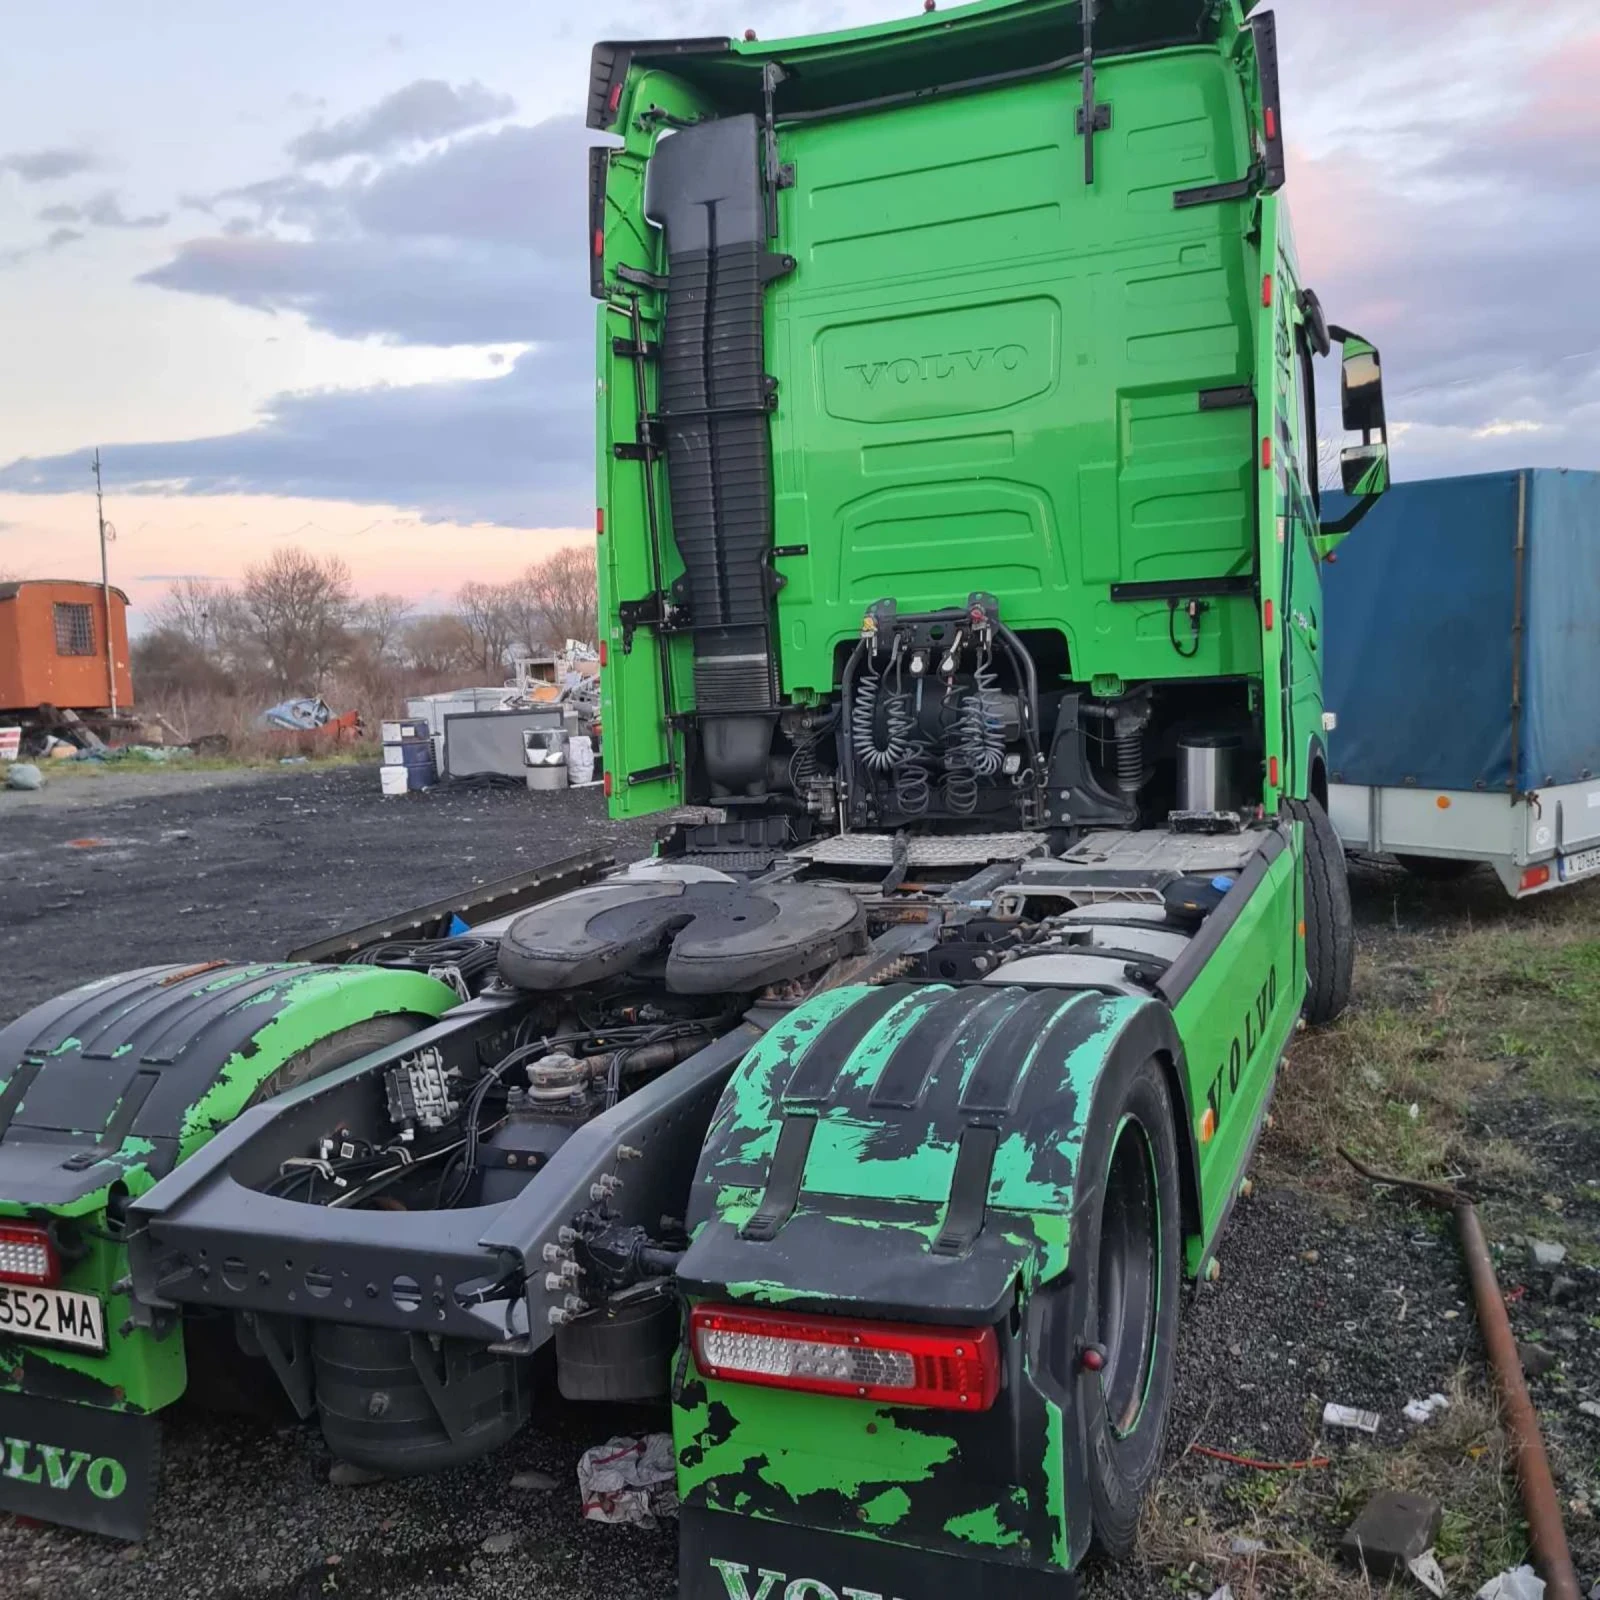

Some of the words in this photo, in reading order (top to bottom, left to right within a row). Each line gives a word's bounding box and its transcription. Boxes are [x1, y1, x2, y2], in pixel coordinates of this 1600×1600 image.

[843, 343, 1029, 391] VOLVO
[1207, 964, 1276, 1134] VOLVO
[55, 1295, 97, 1340] MA
[0, 1436, 127, 1499] LVO
